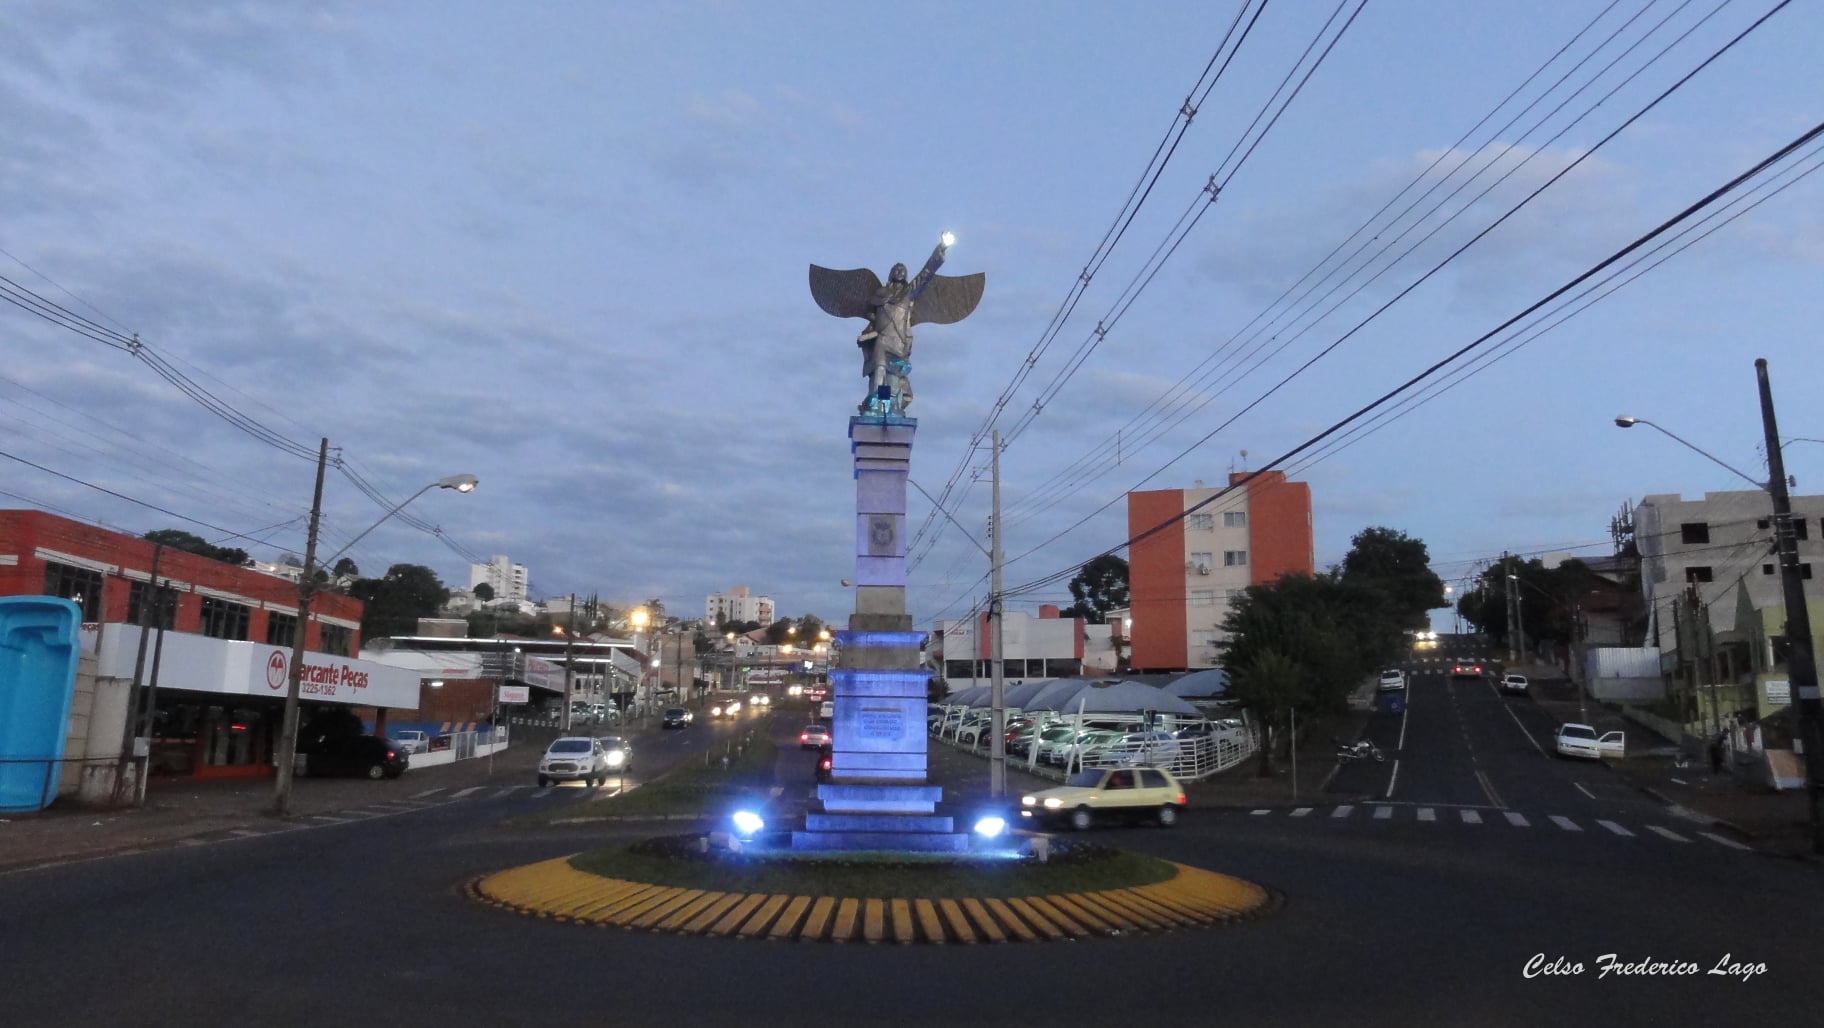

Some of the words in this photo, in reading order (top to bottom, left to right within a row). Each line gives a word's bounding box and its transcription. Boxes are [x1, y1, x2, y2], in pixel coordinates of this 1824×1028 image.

[293, 662, 340, 685] arcante
[341, 664, 369, 694] Peças
[302, 682, 337, 696] 3225-1362
